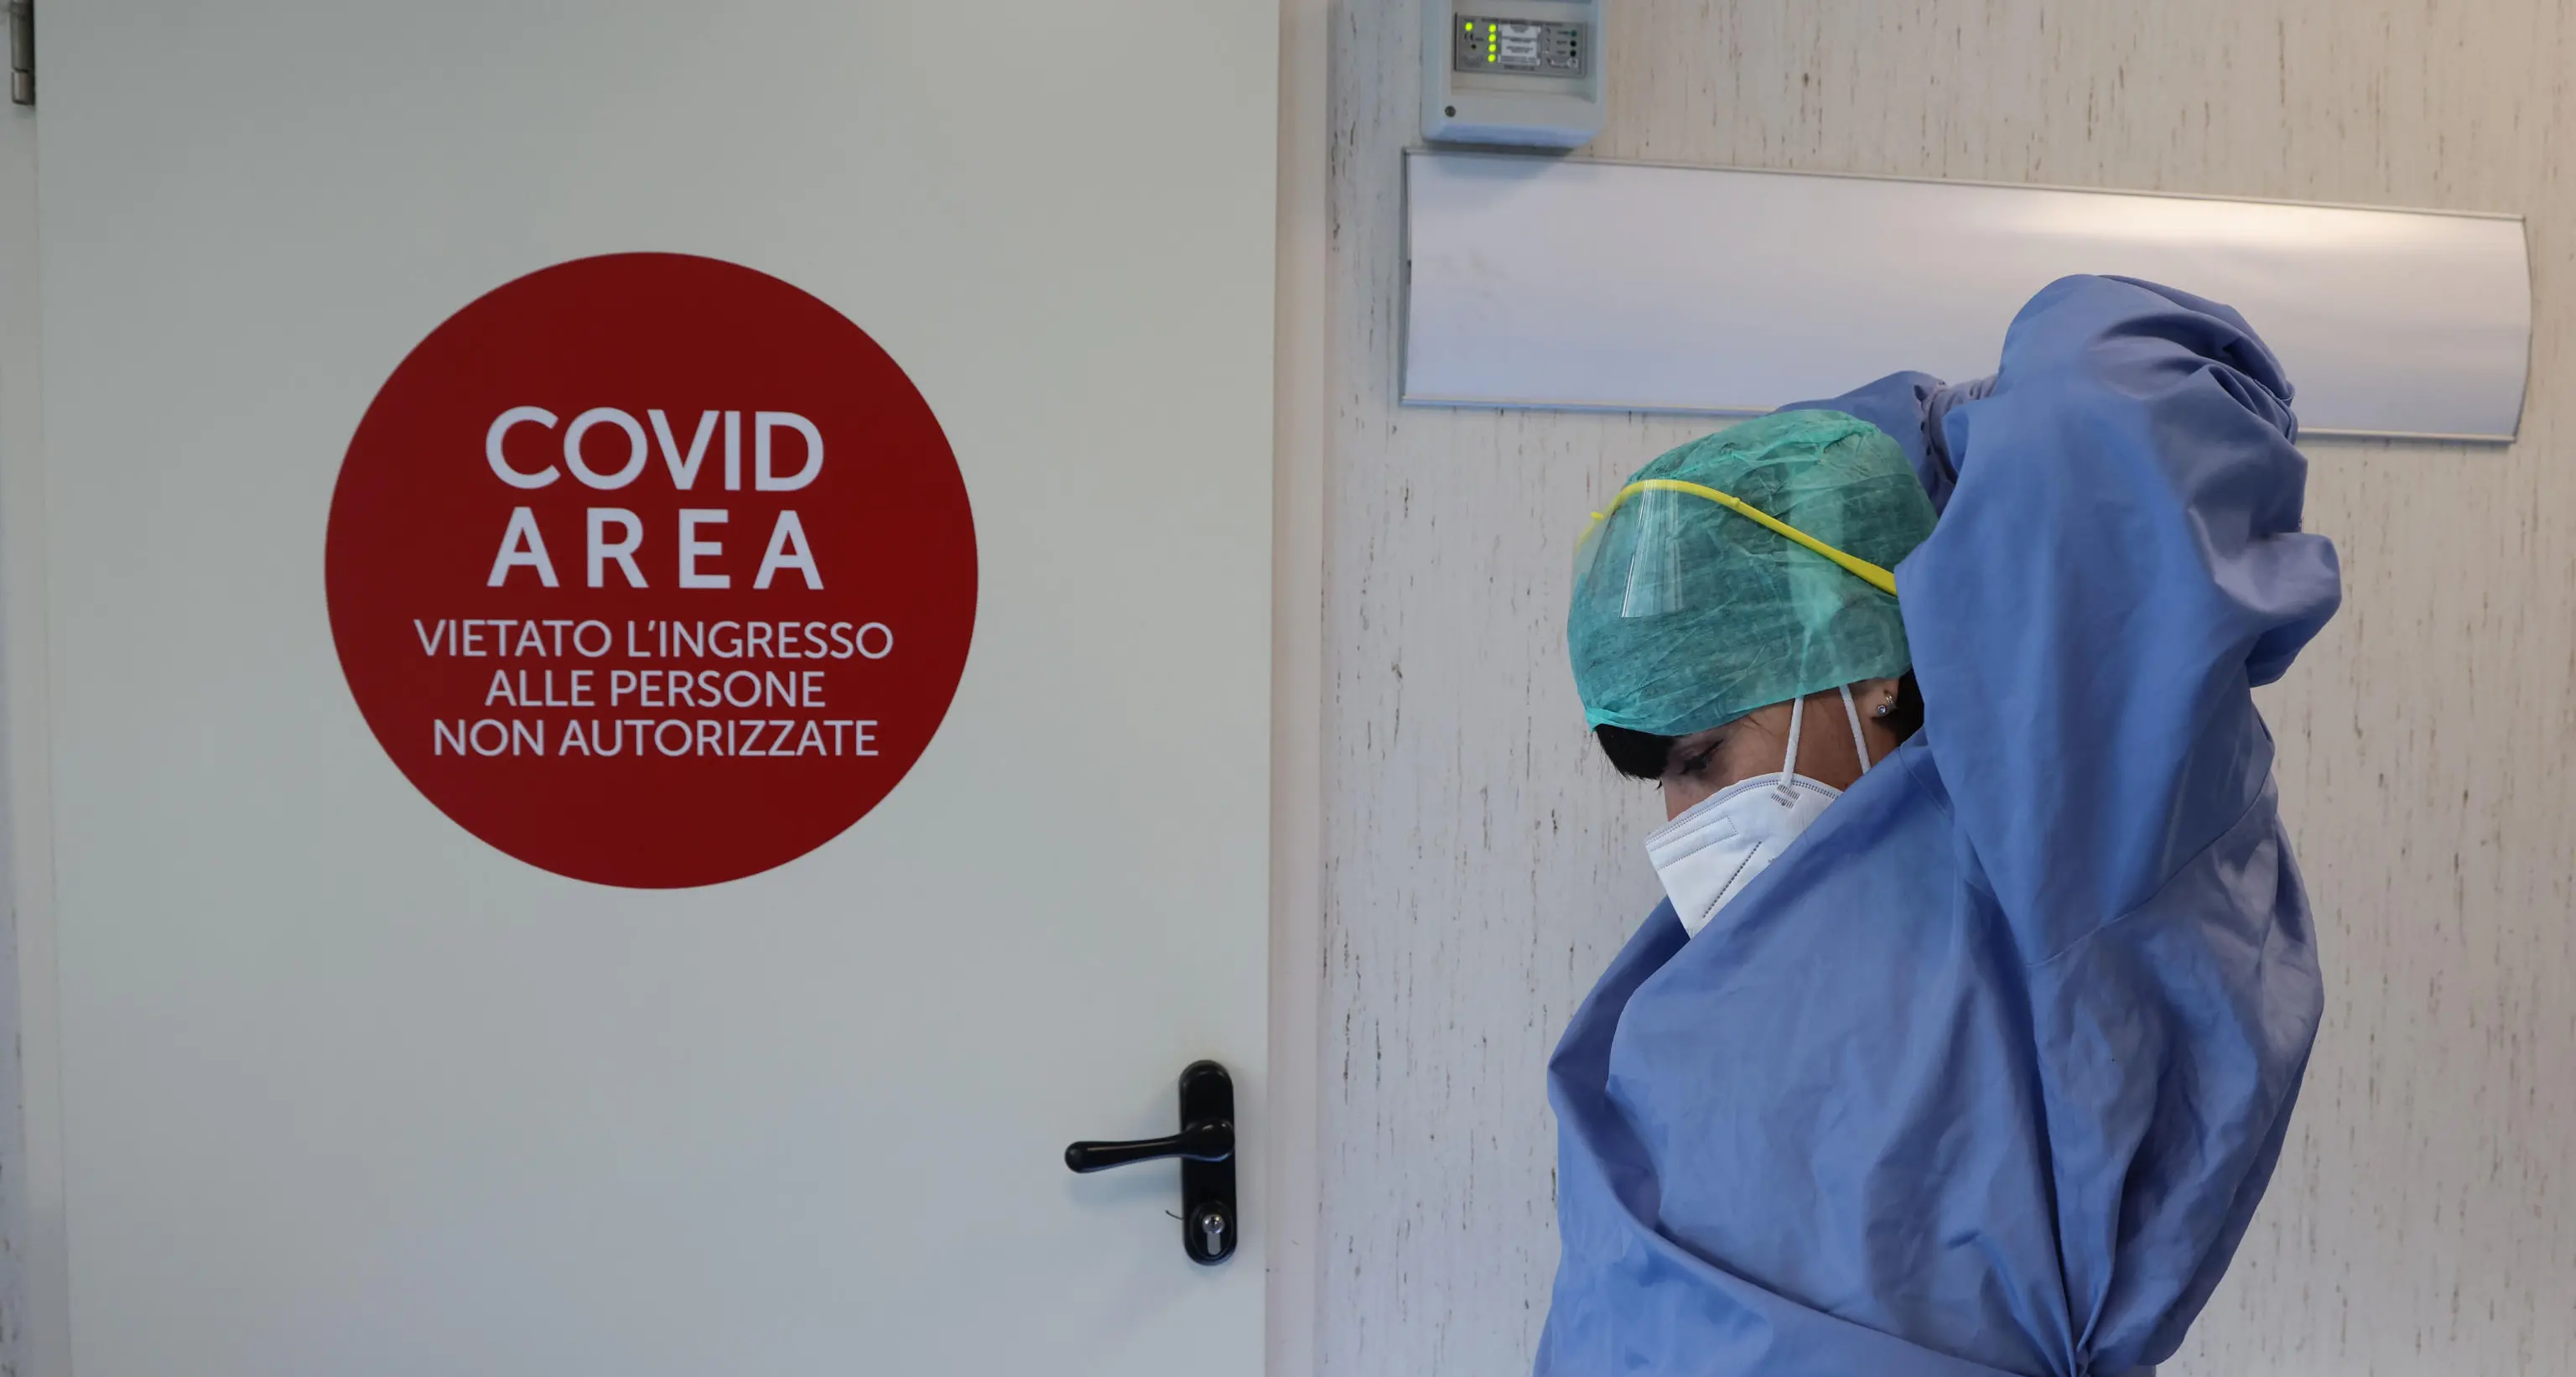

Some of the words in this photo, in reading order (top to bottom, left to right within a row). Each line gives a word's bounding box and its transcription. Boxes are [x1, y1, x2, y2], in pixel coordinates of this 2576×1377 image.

[486, 405, 824, 491] COVID
[486, 506, 824, 590] AREA
[413, 619, 612, 657] VIETATO
[627, 620, 894, 659] L'INGRESSO
[485, 669, 595, 707] ALLE
[610, 669, 826, 708] PERSONE
[434, 719, 544, 756] NON
[558, 719, 879, 756] AUTORIZZATE
